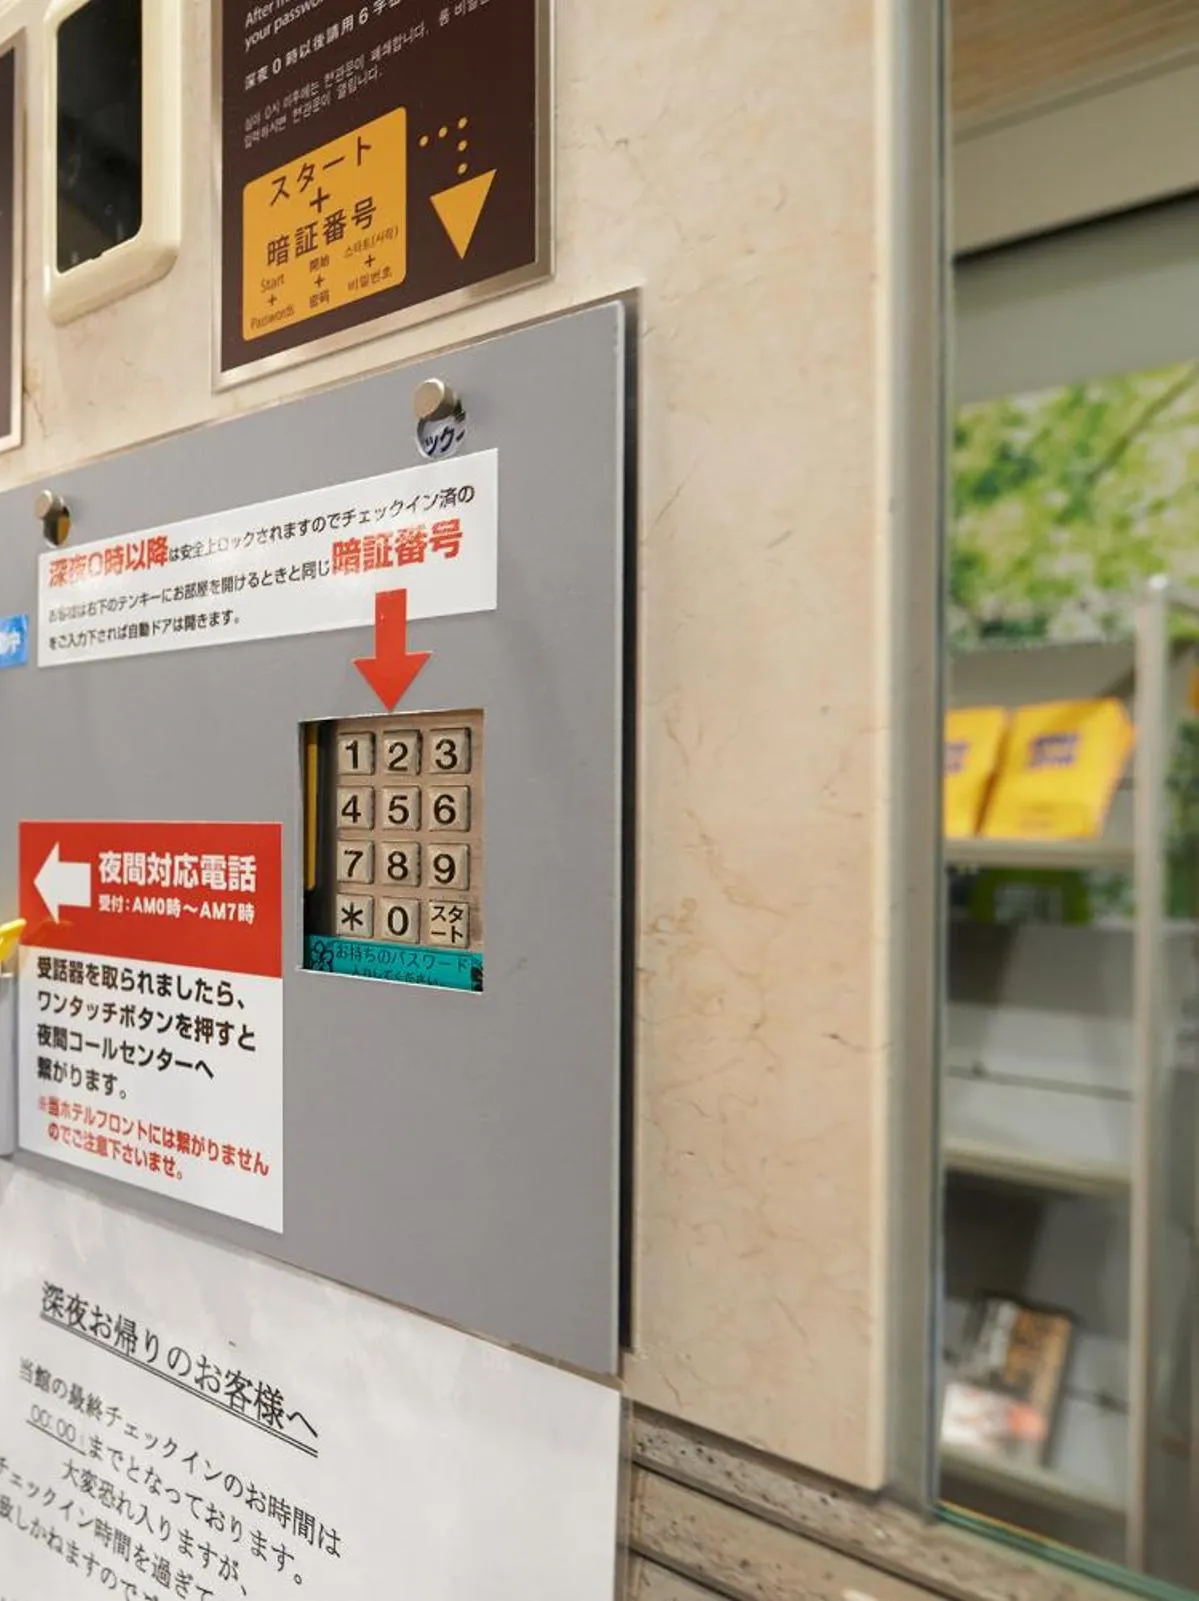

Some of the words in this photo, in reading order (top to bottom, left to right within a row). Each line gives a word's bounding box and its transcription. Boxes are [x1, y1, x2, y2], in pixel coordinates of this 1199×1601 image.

[244, 24, 272, 52] your
[273, 0, 323, 34] passwo
[245, 1, 273, 28] After
[270, 136, 372, 207] スタート
[267, 196, 376, 267] 暗証番号
[260, 273, 285, 293] Start
[346, 740, 359, 769] 1
[388, 742, 408, 771] 2
[435, 738, 457, 769] 3
[341, 795, 361, 823] 4
[388, 795, 409, 824] 5
[434, 794, 456, 824] 6
[98, 851, 257, 893] 夜間対応電話
[344, 850, 363, 877] 7
[387, 851, 408, 880] 8
[433, 853, 456, 884] 9
[387, 906, 409, 936] 0
[37, 955, 245, 1010] 受話器を取られましたら、
[37, 989, 257, 1053] ワンタッチボタンを押すと
[37, 1024, 215, 1080] 夜間コールセンターへ
[37, 1056, 127, 1100] 繋がります。
[48, 1121, 183, 1181] のでご注意下さいませ。
[41, 1281, 318, 1438] 深夜お帰りのお客様へ
[19, 1357, 342, 1559] 当館の最終チェックインのお時間は
[62, 1459, 247, 1597] 大変恐れ入りますが、
[88, 1434, 304, 1587] までとなっております。
